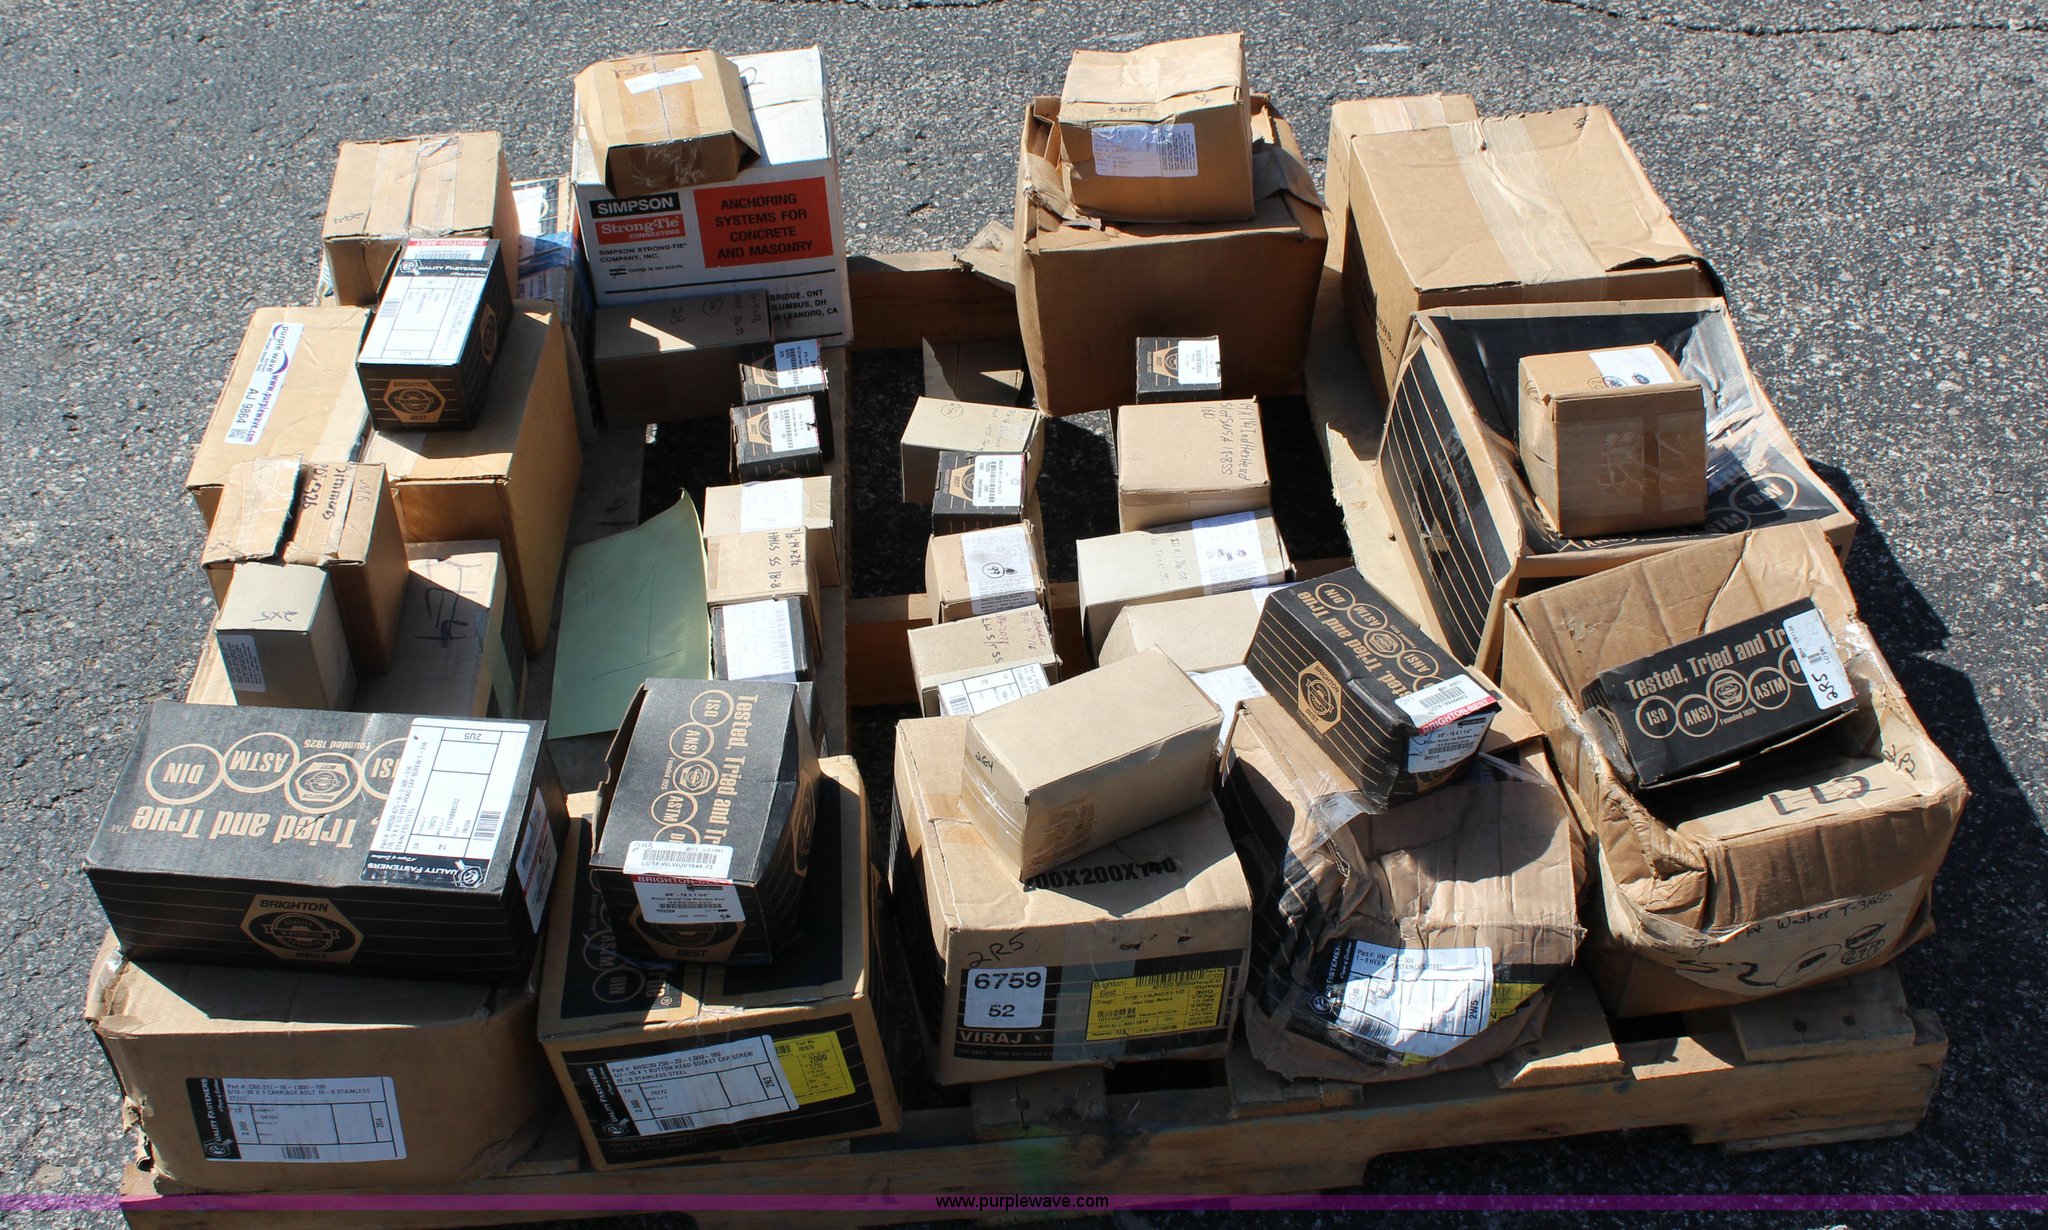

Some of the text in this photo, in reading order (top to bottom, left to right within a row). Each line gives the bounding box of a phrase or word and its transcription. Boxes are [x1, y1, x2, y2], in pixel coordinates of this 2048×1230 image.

[597, 197, 674, 215] SIMPSON
[720, 193, 798, 211] ANCHORING
[715, 209, 808, 228] SYSTEMS FOR
[629, 229, 680, 239] CONNECTORS
[730, 226, 797, 243] CONCRETE
[599, 248, 635, 256] SIMPSON
[600, 255, 642, 263] COMPANY,
[717, 240, 813, 260] AND MASONRY
[806, 289, 824, 298] ONT
[815, 299, 827, 307] OH
[783, 307, 838, 319] LEANDRO, CA
[268, 326, 289, 373] purple wave
[393, 380, 428, 389] BRIGHTON
[236, 388, 259, 424] AJ 9864
[248, 375, 279, 443] www.purplewave.com
[1297, 591, 1323, 620] True
[1324, 588, 1346, 604] DIN
[1353, 605, 1381, 628] ASTM
[1326, 617, 1353, 640] and
[1344, 640, 1382, 673] Tried
[1405, 653, 1431, 673] ANSI
[1624, 664, 1688, 700] Tested,
[1687, 645, 1734, 678] Tried
[1735, 634, 1762, 660] and
[1314, 665, 1339, 693] BRIGHTON
[1754, 677, 1787, 700] ASTM
[704, 699, 722, 718] ISO
[1305, 707, 1319, 723] BEST
[1423, 699, 1491, 733] BRIGHTON-BEST
[1646, 707, 1668, 726] ISO
[1684, 705, 1712, 726] ANSI
[726, 694, 758, 751] Tested,
[304, 739, 371, 751] Founded 1925
[463, 731, 481, 741] 2U5
[682, 729, 701, 755] ANSI
[229, 750, 290, 773] ASTM
[162, 762, 206, 785] DIN
[718, 755, 746, 797] Tried
[404, 807, 415, 822] STEEL
[663, 795, 684, 823] ASTM
[708, 798, 732, 824] and
[131, 805, 205, 840] True
[210, 809, 269, 841] and
[274, 814, 359, 849] Tried
[367, 862, 423, 873] FASTENERS
[260, 900, 329, 912] BRIGHTON
[1777, 909, 1831, 930] Washer
[1368, 959, 1380, 967] HEX
[610, 976, 626, 995] DIN
[974, 970, 1042, 991] 6759
[1094, 980, 1124, 990] Brighton
[1100, 989, 1116, 998] Best
[988, 1004, 1015, 1018] 52
[1468, 1000, 1479, 1019] 2W5
[960, 1030, 1023, 1044] VIRAJ
[648, 1064, 670, 1073] BUTTON
[671, 1062, 689, 1070] HEAD
[691, 1058, 715, 1068] SOCKET
[717, 1055, 732, 1064] CAP
[733, 1051, 754, 1062] SCREW
[809, 1053, 828, 1063] 2000
[632, 1072, 666, 1082] STAINLESS
[667, 1070, 687, 1078] STEEL
[587, 1067, 610, 1107] FASTENERS
[203, 1079, 214, 1121] FASTENERS
